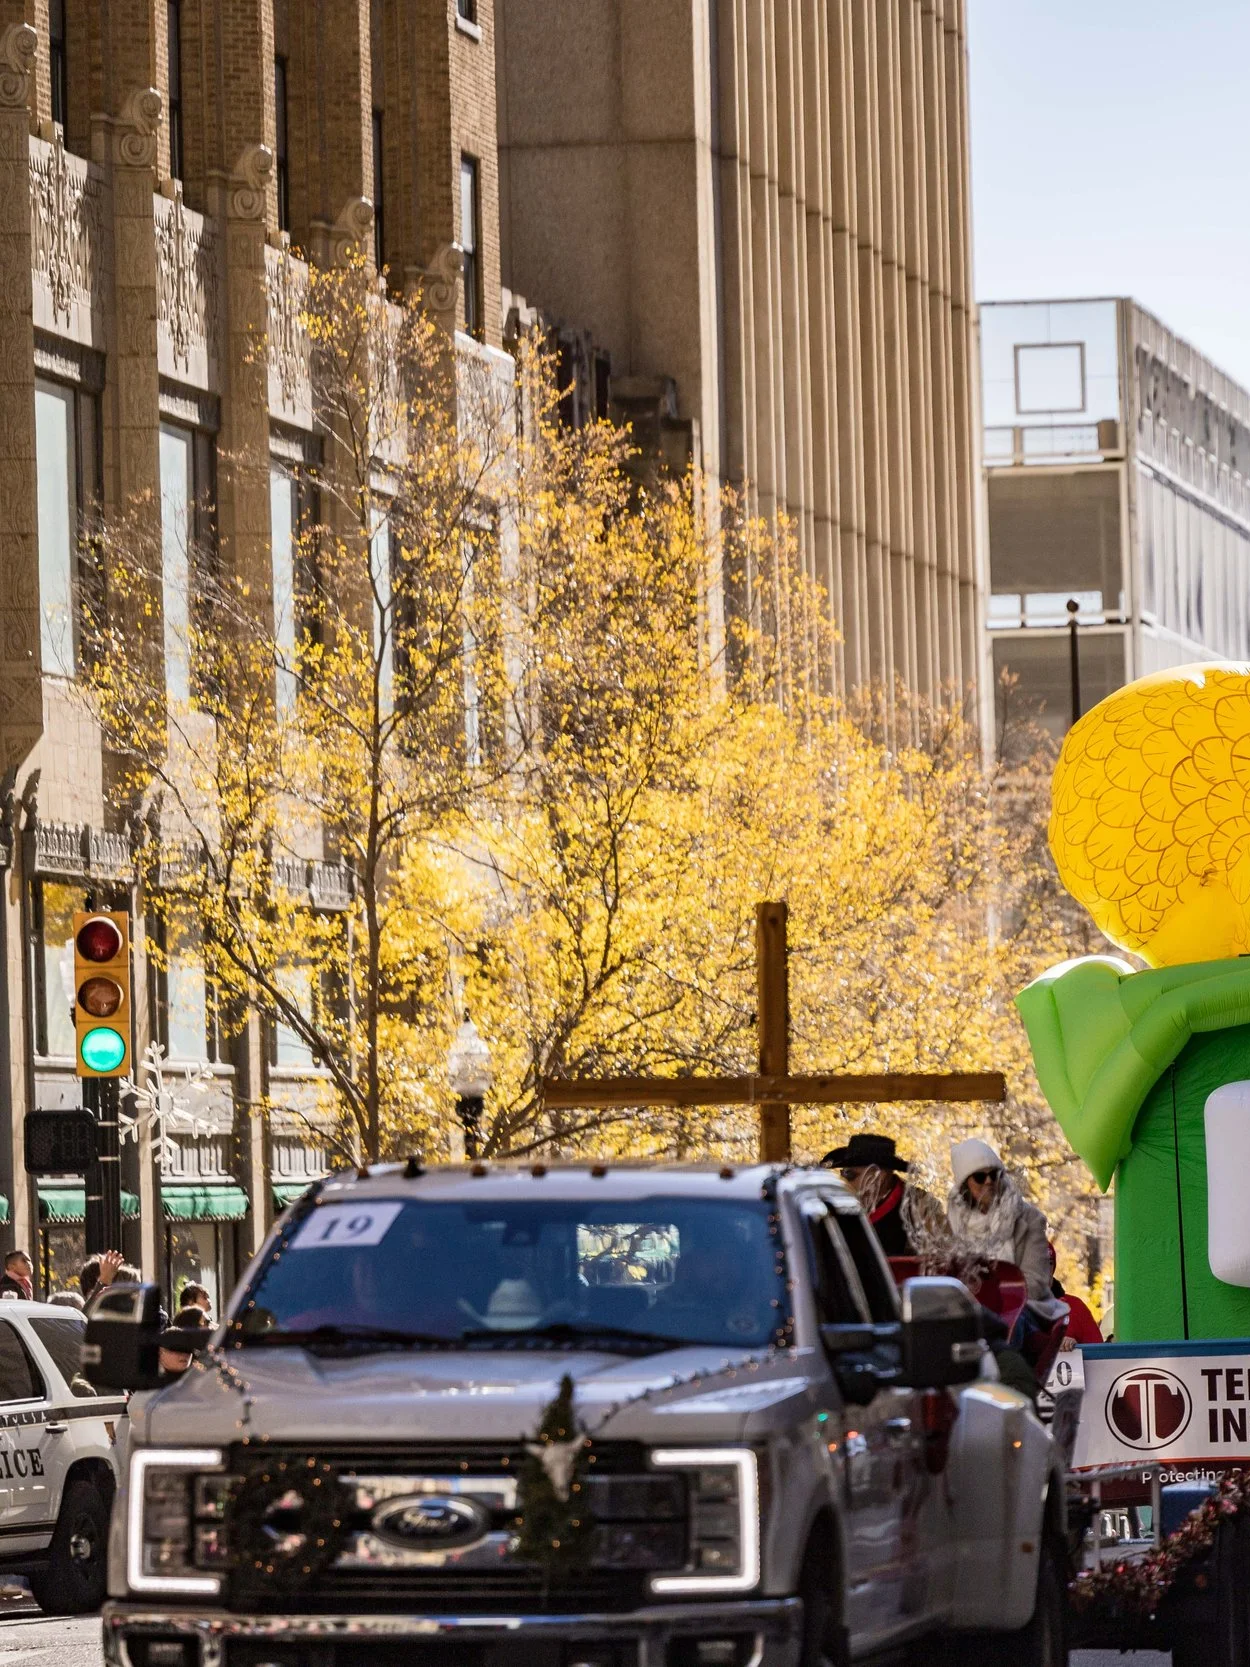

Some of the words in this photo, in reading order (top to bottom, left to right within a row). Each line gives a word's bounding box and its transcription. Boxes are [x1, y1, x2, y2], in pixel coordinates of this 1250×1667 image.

[319, 1214, 375, 1241] 19
[1045, 1361, 1073, 1388] 0
[0, 1448, 45, 1479] ICE
